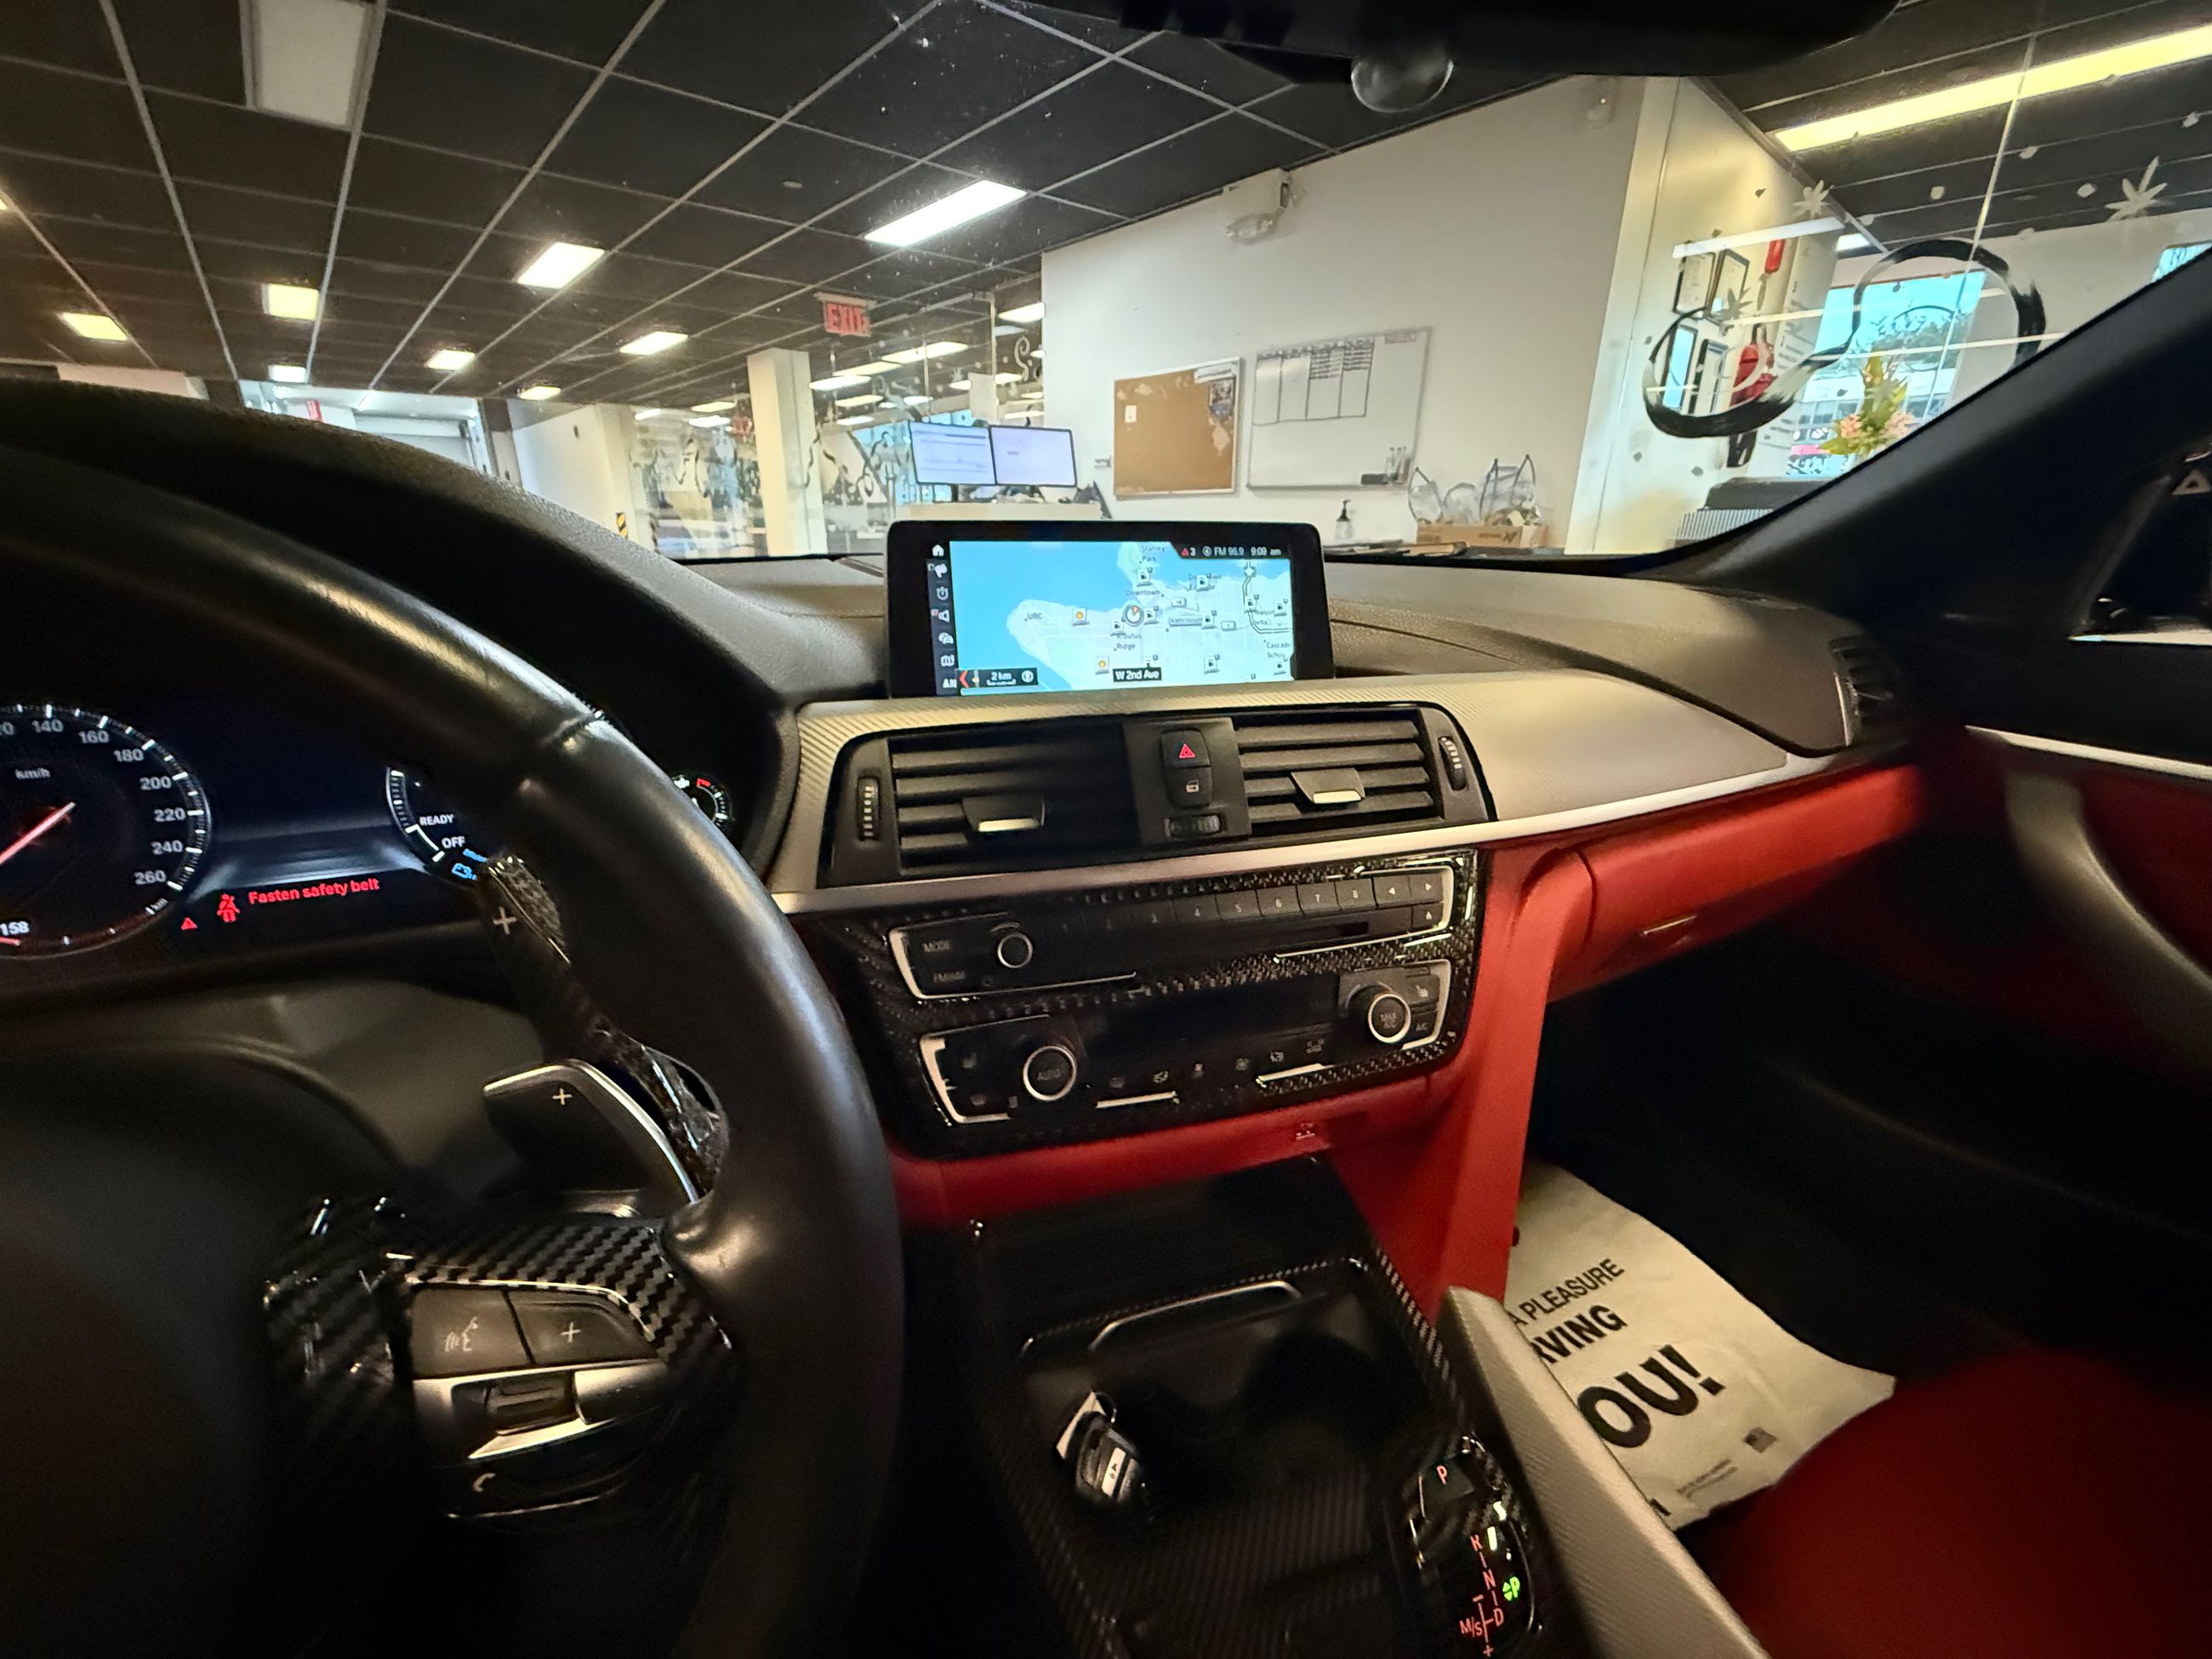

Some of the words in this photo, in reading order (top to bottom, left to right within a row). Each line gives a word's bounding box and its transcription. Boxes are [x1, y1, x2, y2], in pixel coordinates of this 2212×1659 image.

[827, 304, 867, 334] EXIT
[1190, 547, 1196, 556] 3
[1214, 547, 1226, 556] FM
[991, 671, 997, 681] 2
[998, 671, 1012, 681] km
[1115, 670, 1125, 680] W
[1126, 670, 1142, 680] 2nd
[1143, 669, 1160, 679] Ave
[31, 719, 64, 733] 140
[78, 730, 110, 744] 160
[114, 749, 144, 763] 180
[15, 767, 51, 780] km/h
[140, 776, 171, 790] 200
[154, 807, 185, 823] 220
[419, 813, 455, 827] READY
[151, 840, 183, 855] 240
[442, 835, 465, 850] OFF
[134, 869, 166, 886] 260
[248, 891, 300, 905] Fasten
[301, 882, 349, 898] safety
[350, 877, 380, 893] belt
[1519, 1257, 1626, 1321] PLEASURE
[1435, 1464, 1447, 1485] P
[1482, 1568, 1497, 1590] N
[1493, 1607, 1504, 1628] D
